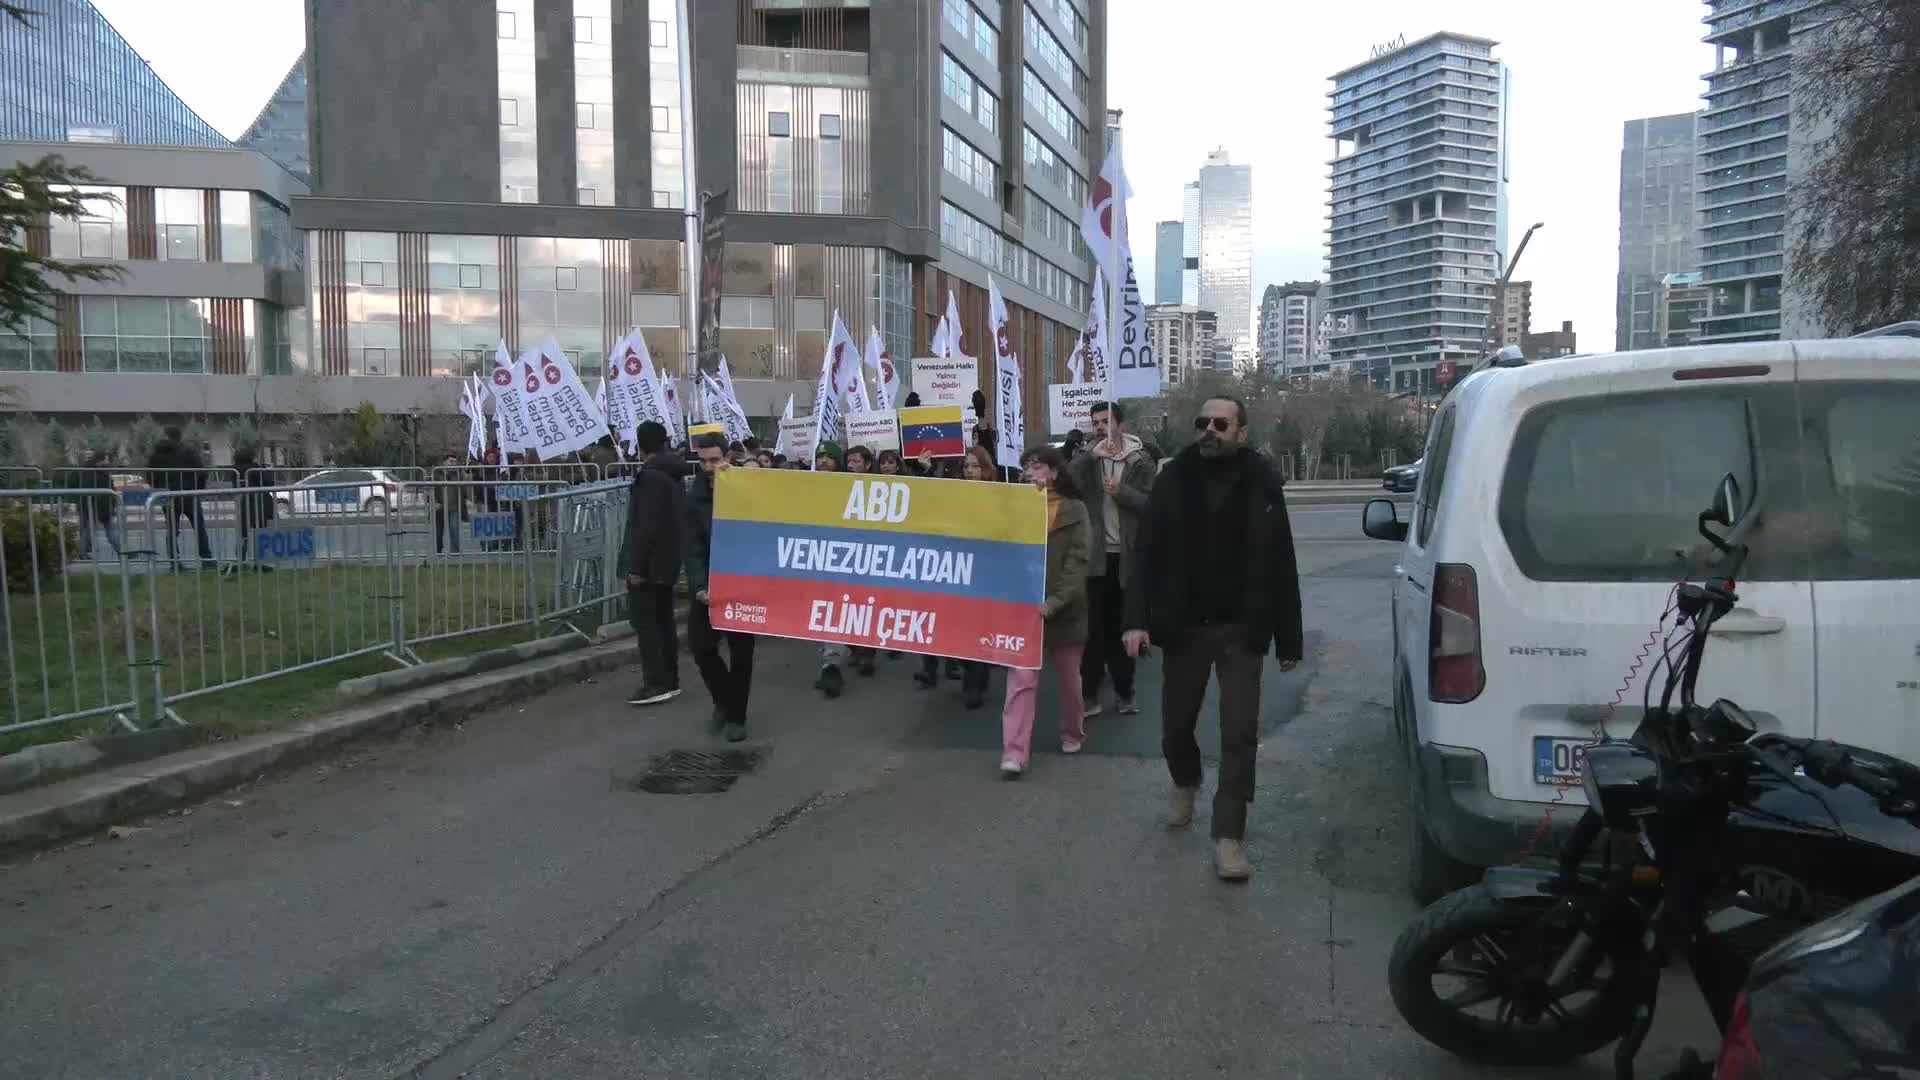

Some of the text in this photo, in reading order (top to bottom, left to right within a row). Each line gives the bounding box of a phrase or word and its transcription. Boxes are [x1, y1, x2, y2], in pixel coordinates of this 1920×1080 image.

[1062, 400, 1075, 408] Her
[843, 480, 911, 523] ABD
[777, 537, 974, 585] VENEZUELA'DAN
[735, 602, 767, 613] Devrim
[735, 611, 767, 624] Partisi
[808, 594, 935, 646] ELİNİ ÇEK!
[996, 634, 1025, 651] FKF
[1509, 647, 1587, 656] RIFTER
